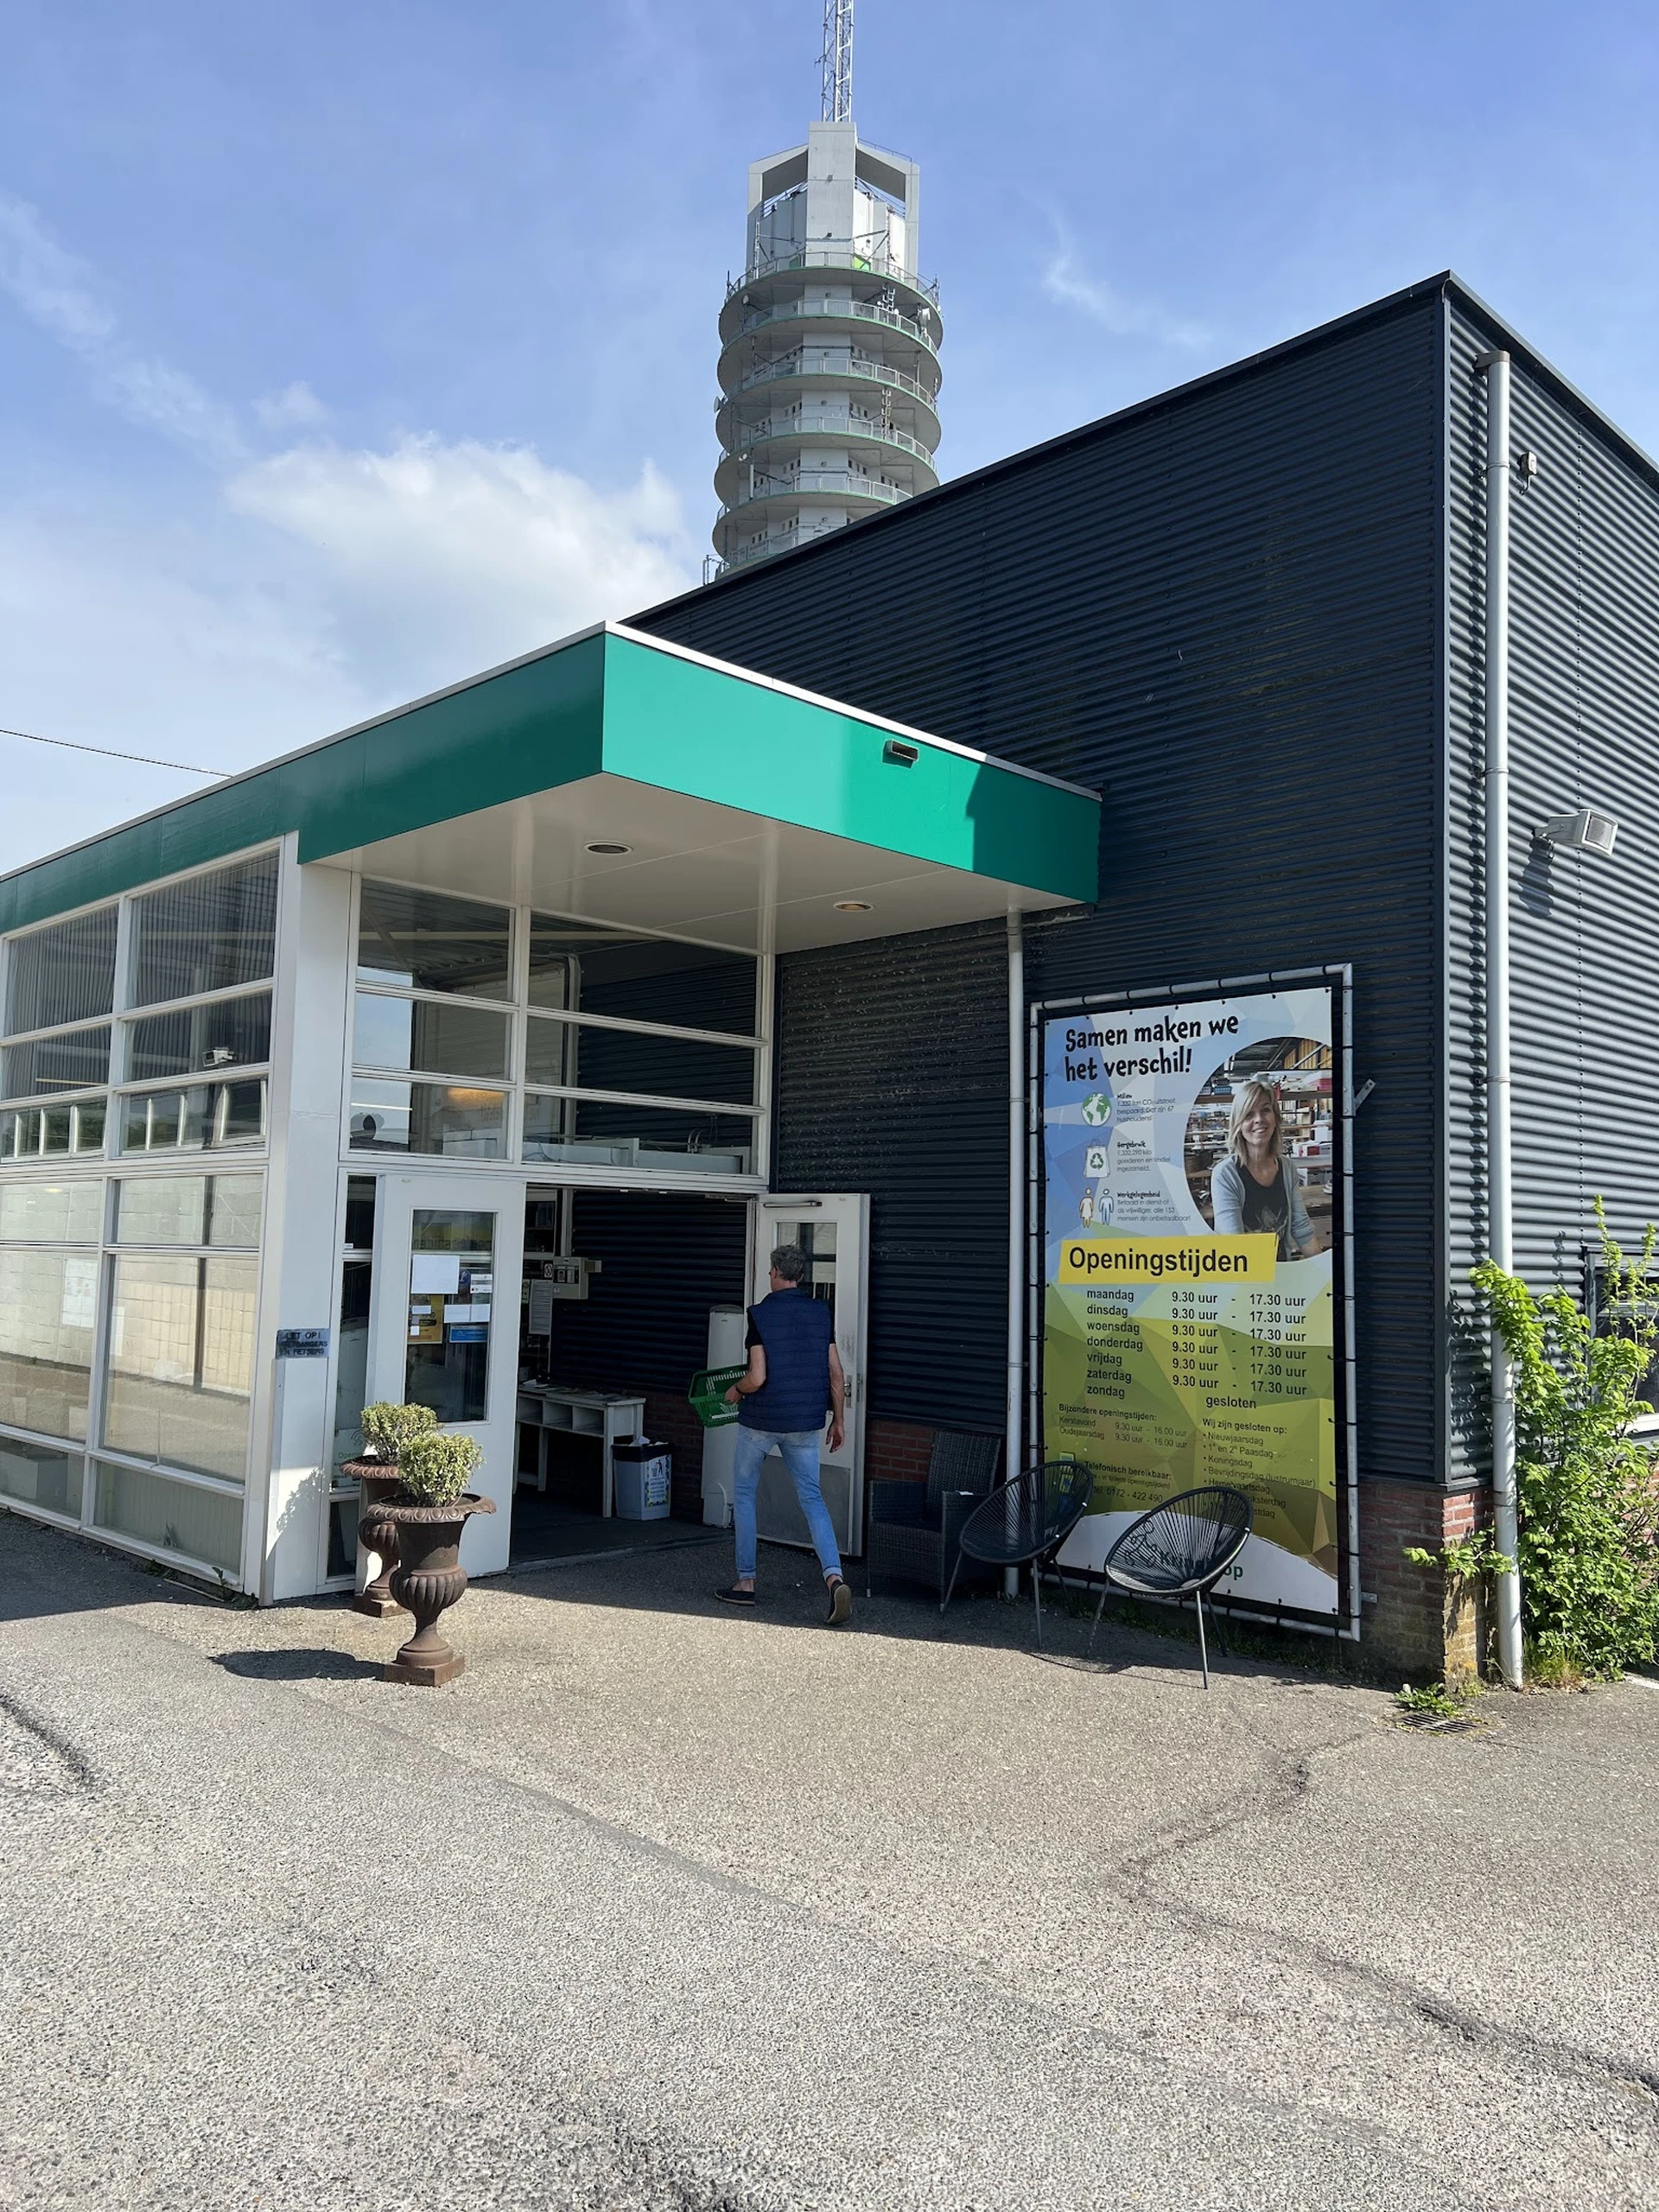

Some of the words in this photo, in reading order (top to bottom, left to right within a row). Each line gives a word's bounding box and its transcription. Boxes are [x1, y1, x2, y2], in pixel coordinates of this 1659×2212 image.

[1065, 1029, 1128, 1052] Samen
[1135, 1015, 1201, 1043] maken
[1209, 1015, 1238, 1035] we
[1065, 1056, 1097, 1081] het
[1103, 1046, 1192, 1077] verschil!
[1069, 1247, 1248, 1276] Openingstijden
[1087, 1290, 1134, 1302] maandag
[1172, 1292, 1195, 1302] 9.30
[1198, 1294, 1217, 1303] uur
[1249, 1294, 1281, 1306] 17.30
[1285, 1298, 1306, 1306] uur
[1087, 1305, 1128, 1317] dinsdag
[1172, 1309, 1195, 1319] 9.30
[1198, 1312, 1218, 1320] uur
[1250, 1312, 1281, 1322] 17.30
[1286, 1314, 1306, 1324] uur
[1087, 1321, 1140, 1335] woensdag
[1172, 1325, 1195, 1336] 9.30
[1199, 1328, 1218, 1337] uur
[1250, 1329, 1281, 1339] 17.30
[1286, 1332, 1306, 1342] uur
[1087, 1337, 1142, 1351] donderdag
[1173, 1342, 1195, 1353] 9.30
[1199, 1344, 1218, 1354] uur
[1250, 1346, 1281, 1357] 17.30
[1286, 1351, 1306, 1359] uur
[1087, 1353, 1122, 1366] vrijdag
[1173, 1358, 1195, 1370] 9.30
[1199, 1362, 1218, 1371] uur
[1250, 1363, 1281, 1376] 17.30
[1286, 1368, 1306, 1377] uur
[1087, 1369, 1131, 1383] zaterdag
[1173, 1376, 1195, 1386] 9.30
[1199, 1379, 1218, 1389] uur
[1251, 1382, 1281, 1393] 17.30
[1286, 1385, 1306, 1395] uur
[1087, 1385, 1125, 1399] zondag
[1205, 1395, 1256, 1408] gesloten
[1058, 1404, 1097, 1415] Bijzondere
[1099, 1409, 1157, 1421] openingstijden:
[1058, 1416, 1096, 1427] Kerstavond
[1154, 1426, 1173, 1436] 16.00
[1203, 1418, 1216, 1428] Wij
[1217, 1421, 1232, 1430] zijn
[1235, 1421, 1271, 1433] gesloten
[1274, 1426, 1287, 1435] op:
[1154, 1437, 1174, 1446] 16.00
[1208, 1433, 1263, 1446] Nieuwjaarsdag
[1208, 1455, 1253, 1468] Koningsdag
[1239, 1446, 1274, 1459] Paasdag
[1084, 1461, 1127, 1474] Telefonisch
[1128, 1467, 1171, 1480] bereikbaar:
[1209, 1466, 1263, 1482] Bevrijdingsdag
[1265, 1474, 1316, 1488] (lustrumjaar)
[1106, 1486, 1124, 1497] 0172
[1132, 1491, 1147, 1501] 422
[1148, 1494, 1162, 1503] 490
[1208, 1478, 1270, 1494] Hemelvaartsdag
